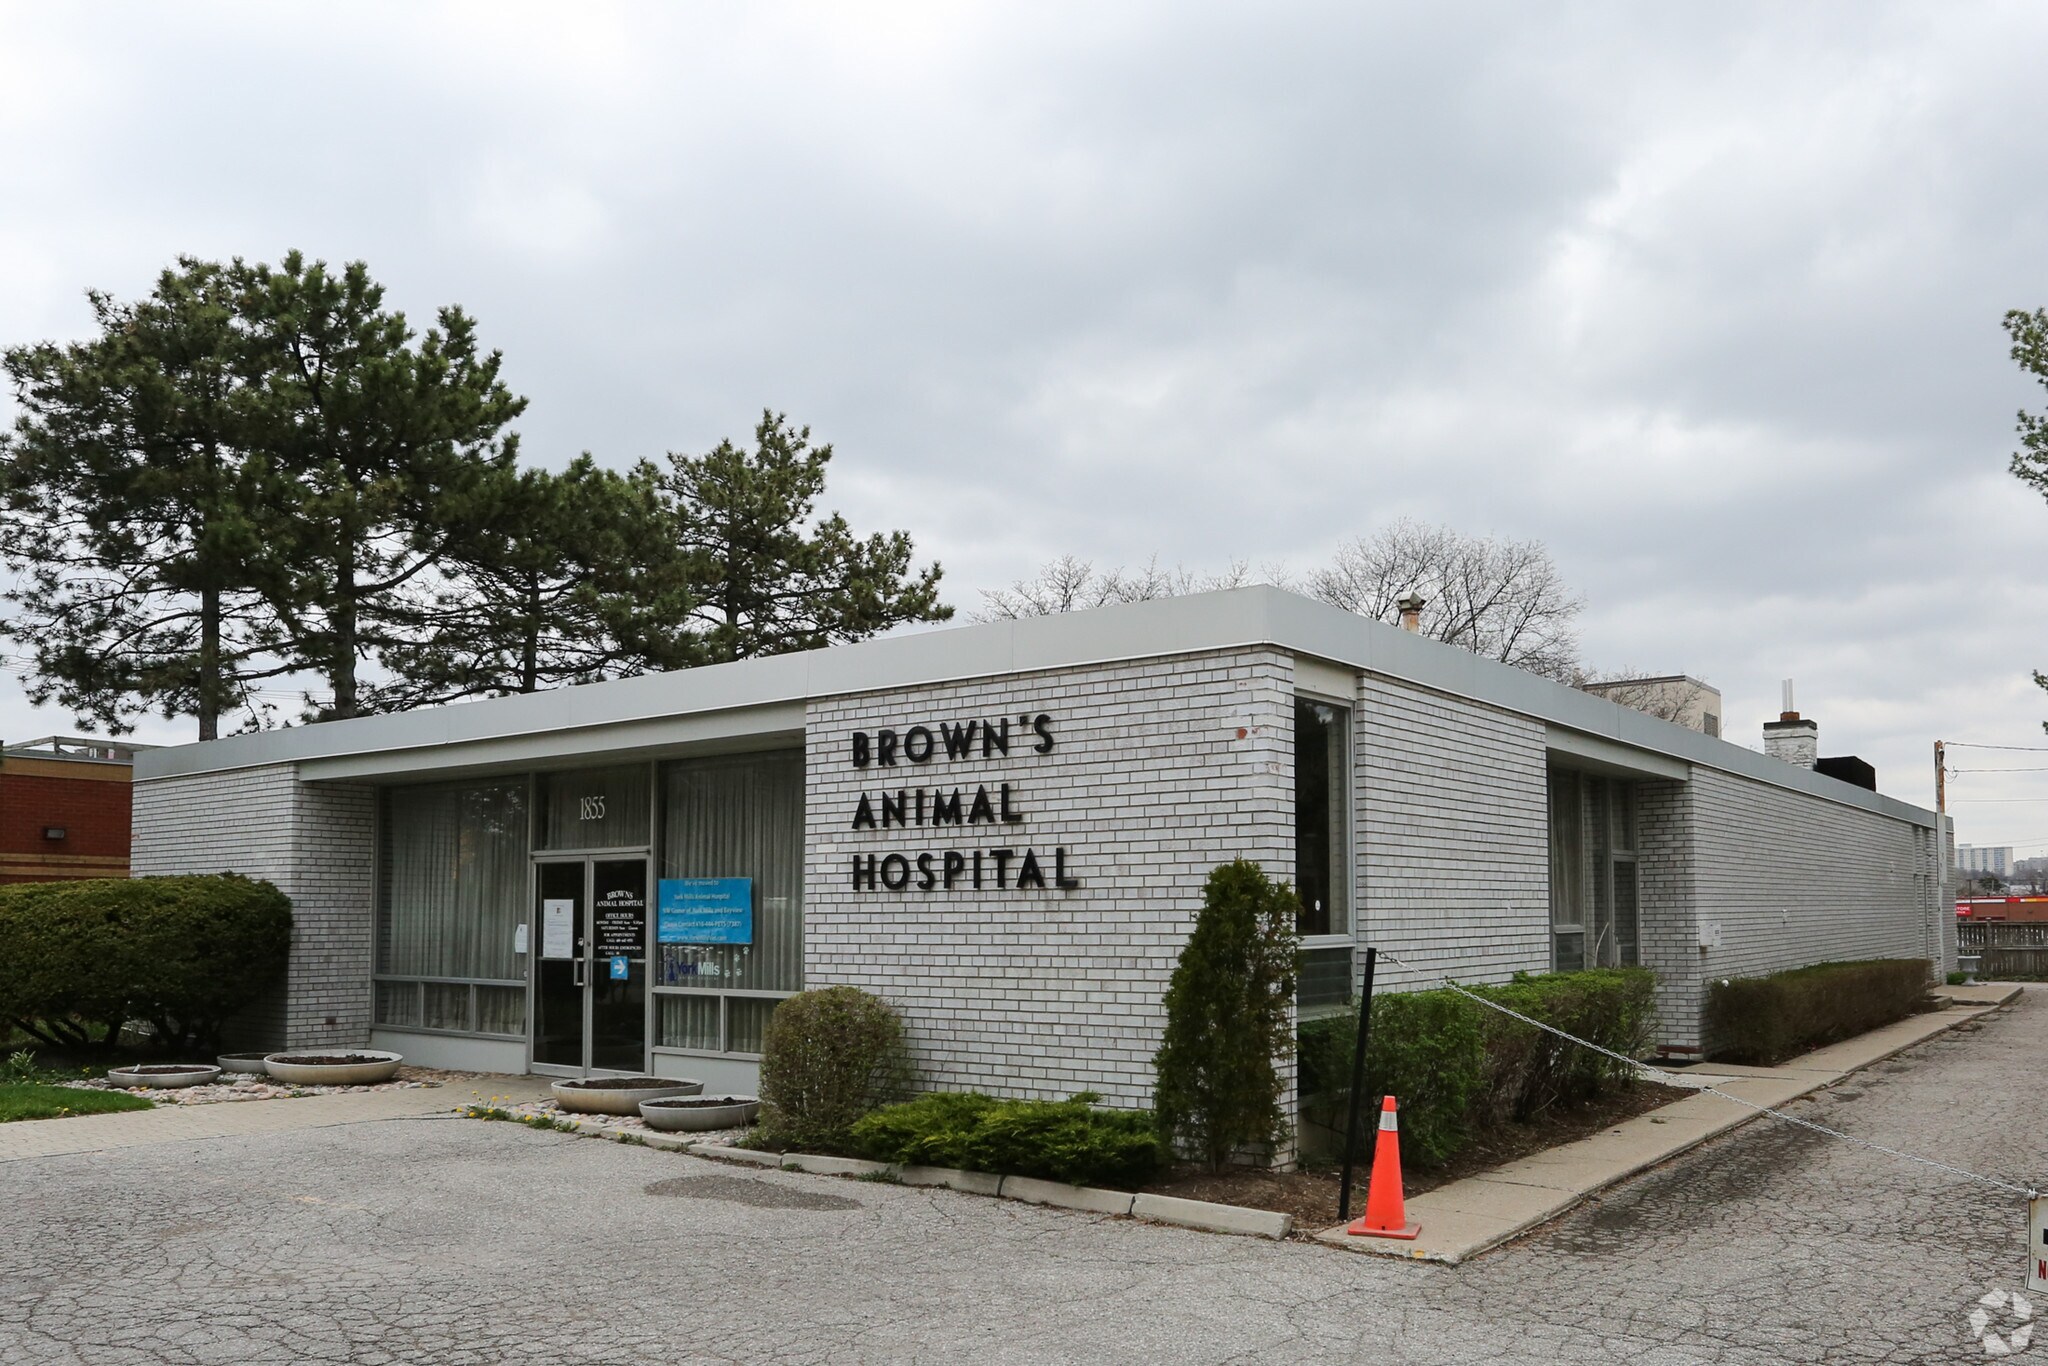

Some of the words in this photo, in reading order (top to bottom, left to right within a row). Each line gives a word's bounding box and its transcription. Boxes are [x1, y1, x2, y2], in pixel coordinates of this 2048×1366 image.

[852, 714, 1054, 768] BROWN'S
[580, 796, 605, 820] 1855
[851, 783, 1022, 829] ANIMAL
[852, 847, 1078, 891] HOSPITAL
[677, 962, 698, 976] York
[698, 962, 720, 976] Mills
